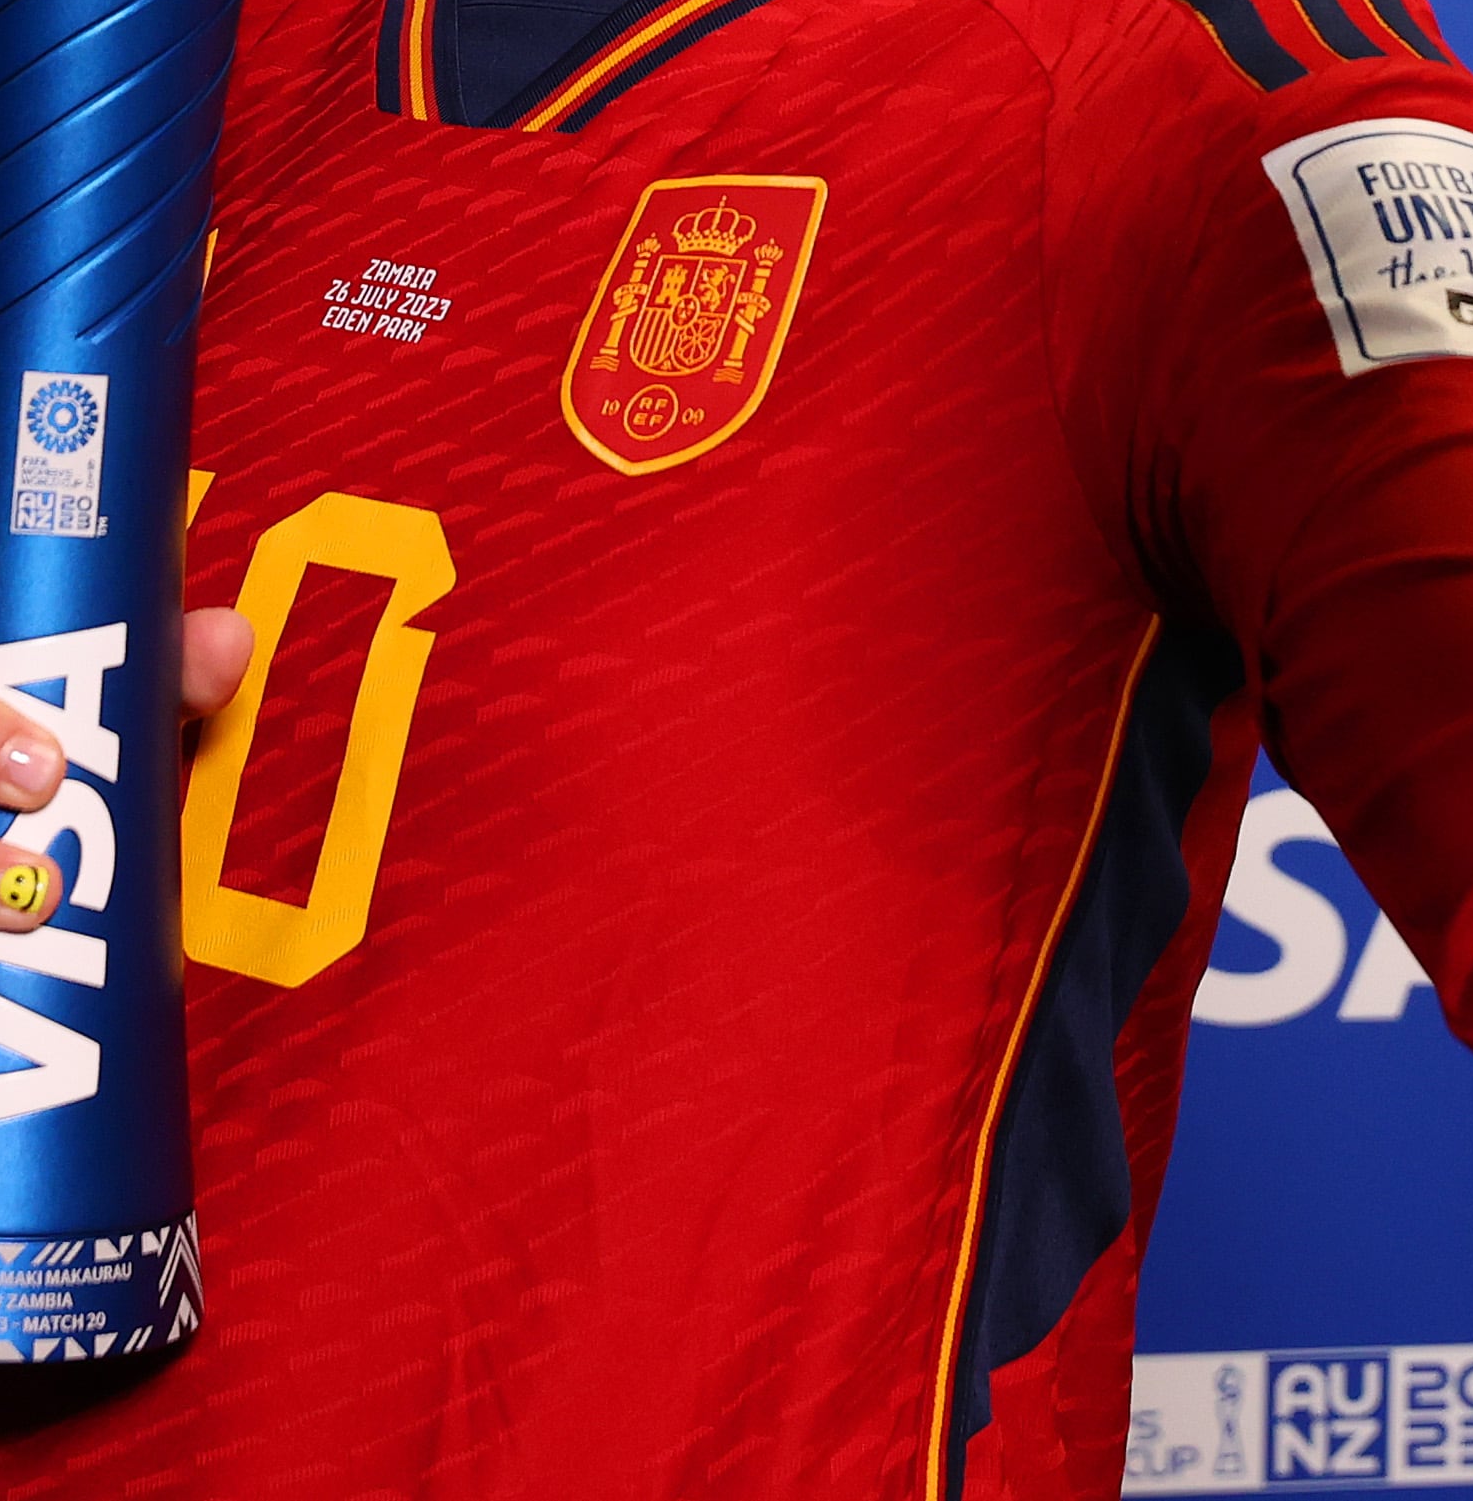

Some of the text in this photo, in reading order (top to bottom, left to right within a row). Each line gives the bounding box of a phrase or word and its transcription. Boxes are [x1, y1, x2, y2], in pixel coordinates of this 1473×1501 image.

[362, 258, 437, 291] ZAMBIA
[324, 279, 451, 321] 26 JULY 2023
[322, 306, 427, 343] EDEN PARK
[19, 492, 54, 509] AU
[61, 494, 92, 512] 20
[17, 509, 54, 529] NZ
[181, 468, 457, 988] 0
[45, 1261, 133, 1286] MAKAURAU
[6, 1291, 74, 1311] ZAMBIA
[22, 1312, 86, 1334] MATCH
[87, 1311, 107, 1330] 20
[1274, 1362, 1384, 1417] AU
[1127, 1444, 1200, 1477] CUP
[1274, 1419, 1382, 1477] NZ
